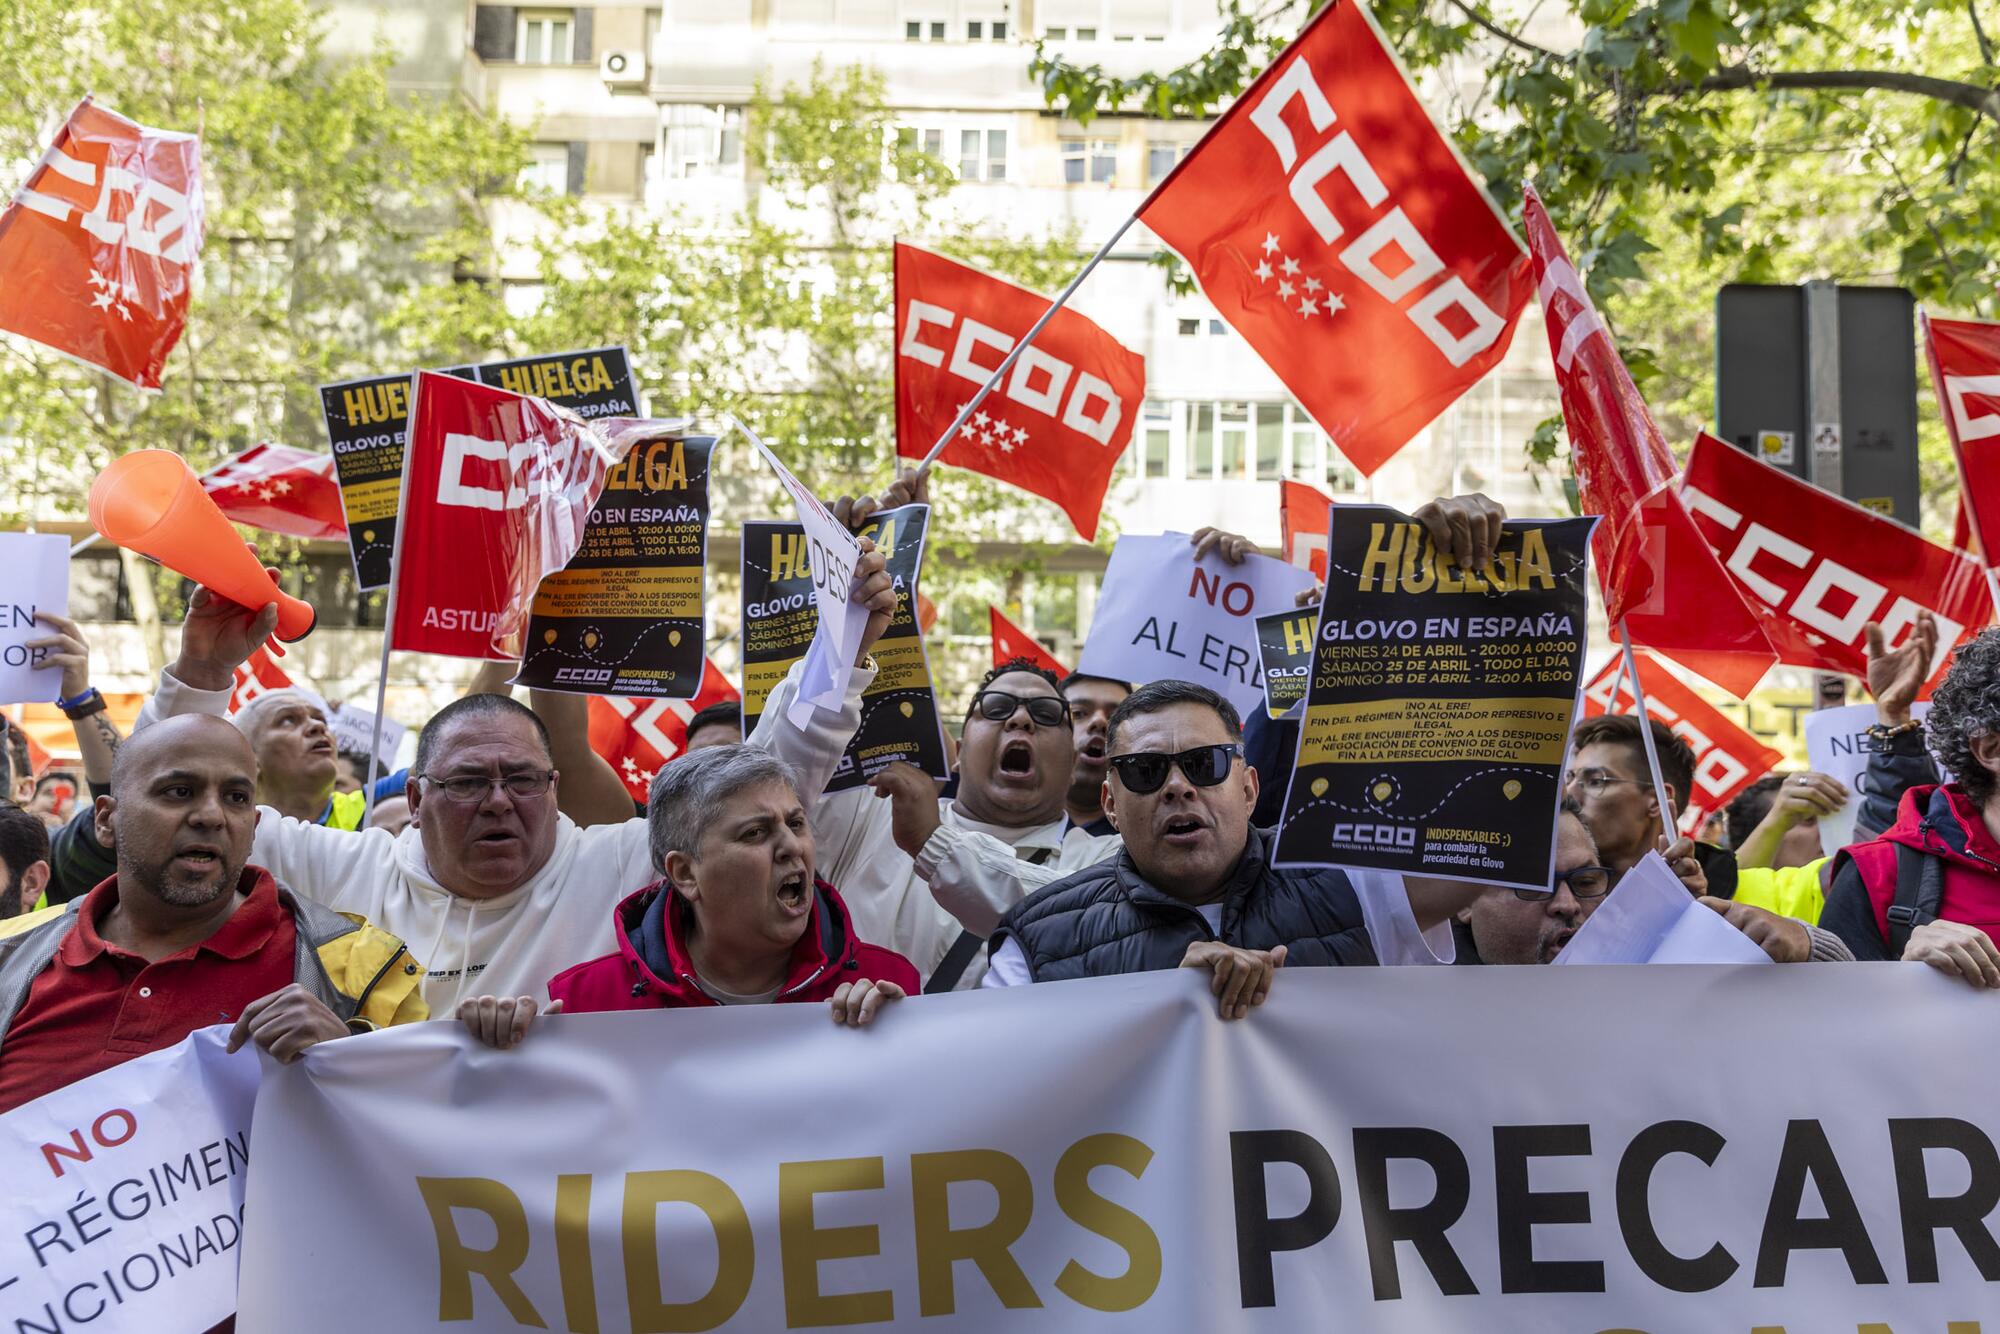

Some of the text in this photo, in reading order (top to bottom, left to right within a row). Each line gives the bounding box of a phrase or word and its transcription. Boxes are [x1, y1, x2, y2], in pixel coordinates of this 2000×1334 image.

[1249, 54, 1507, 368] CCOO
[500, 356, 614, 398] HUELGA
[900, 298, 1122, 447] CCOO
[334, 434, 391, 454] GLOVO
[604, 441, 688, 491] ELGA
[605, 508, 626, 524] EN
[630, 504, 700, 522] ESPAÑA
[596, 527, 607, 536] DE
[608, 526, 632, 536] ABRIL
[638, 525, 664, 535] 20:00
[665, 525, 672, 534] A
[674, 524, 702, 534] 00:00
[588, 534, 698, 547] 25 DE ABRIL TODO EL DÍA
[589, 545, 701, 557] 26 DE ABRIL 12:00 A 16:00
[653, 576, 692, 584] REPRESIVO
[1188, 566, 1255, 617] NO
[747, 593, 804, 618] GLOVO
[747, 611, 809, 630] VIERNES DE
[790, 624, 800, 634] 25
[800, 621, 812, 632] DE
[1322, 620, 1417, 641] GLOVO
[1424, 618, 1460, 638] EN
[1467, 612, 1574, 638] ESPAÑA
[747, 637, 793, 652] DOMINGO
[1131, 616, 1187, 659] AL
[1319, 641, 1577, 659] VIERNES 24 DE ABRIL 20:00 A 00:00
[1268, 666, 1309, 678] GLO
[1321, 654, 1570, 674] SÁBADO 25 DE ABRIL TODO EL DÍA
[555, 667, 613, 681] CCOO
[748, 672, 779, 681] FIN DEL
[1315, 670, 1573, 689] DOMINGO 26 DE ABRIL 12:00 A 16:00
[747, 688, 761, 697] FIN
[1428, 702, 1442, 710] AL
[1446, 702, 1471, 710] ERE!
[1310, 710, 1565, 726] FIN DEL RÉGIMEN SANCIONADOR REPRESIVO E
[1413, 721, 1453, 729] ILEGAL
[1304, 737, 1322, 746] FIN
[1341, 733, 1361, 741] ERE
[1364, 730, 1435, 740] ENCUBIERTO
[1466, 730, 1475, 738] A
[1477, 729, 1500, 738] LOS
[1502, 730, 1563, 742] DESPIDOS!
[1321, 739, 1540, 752] NEGOCIACIÓN DE CONVENIO DE GLOVO
[1337, 748, 1519, 760] FIN A LA PERSECUCIÓN SINDICAL
[1332, 823, 1416, 847] CCOO
[1424, 841, 1487, 855] para combatir la
[1423, 853, 1505, 869] precariedad en Glovo
[40, 1108, 138, 1179] NO
[24, 1131, 249, 1268] RÉGIMEN
[415, 1116, 2000, 1334] RIDERS PRECAR
